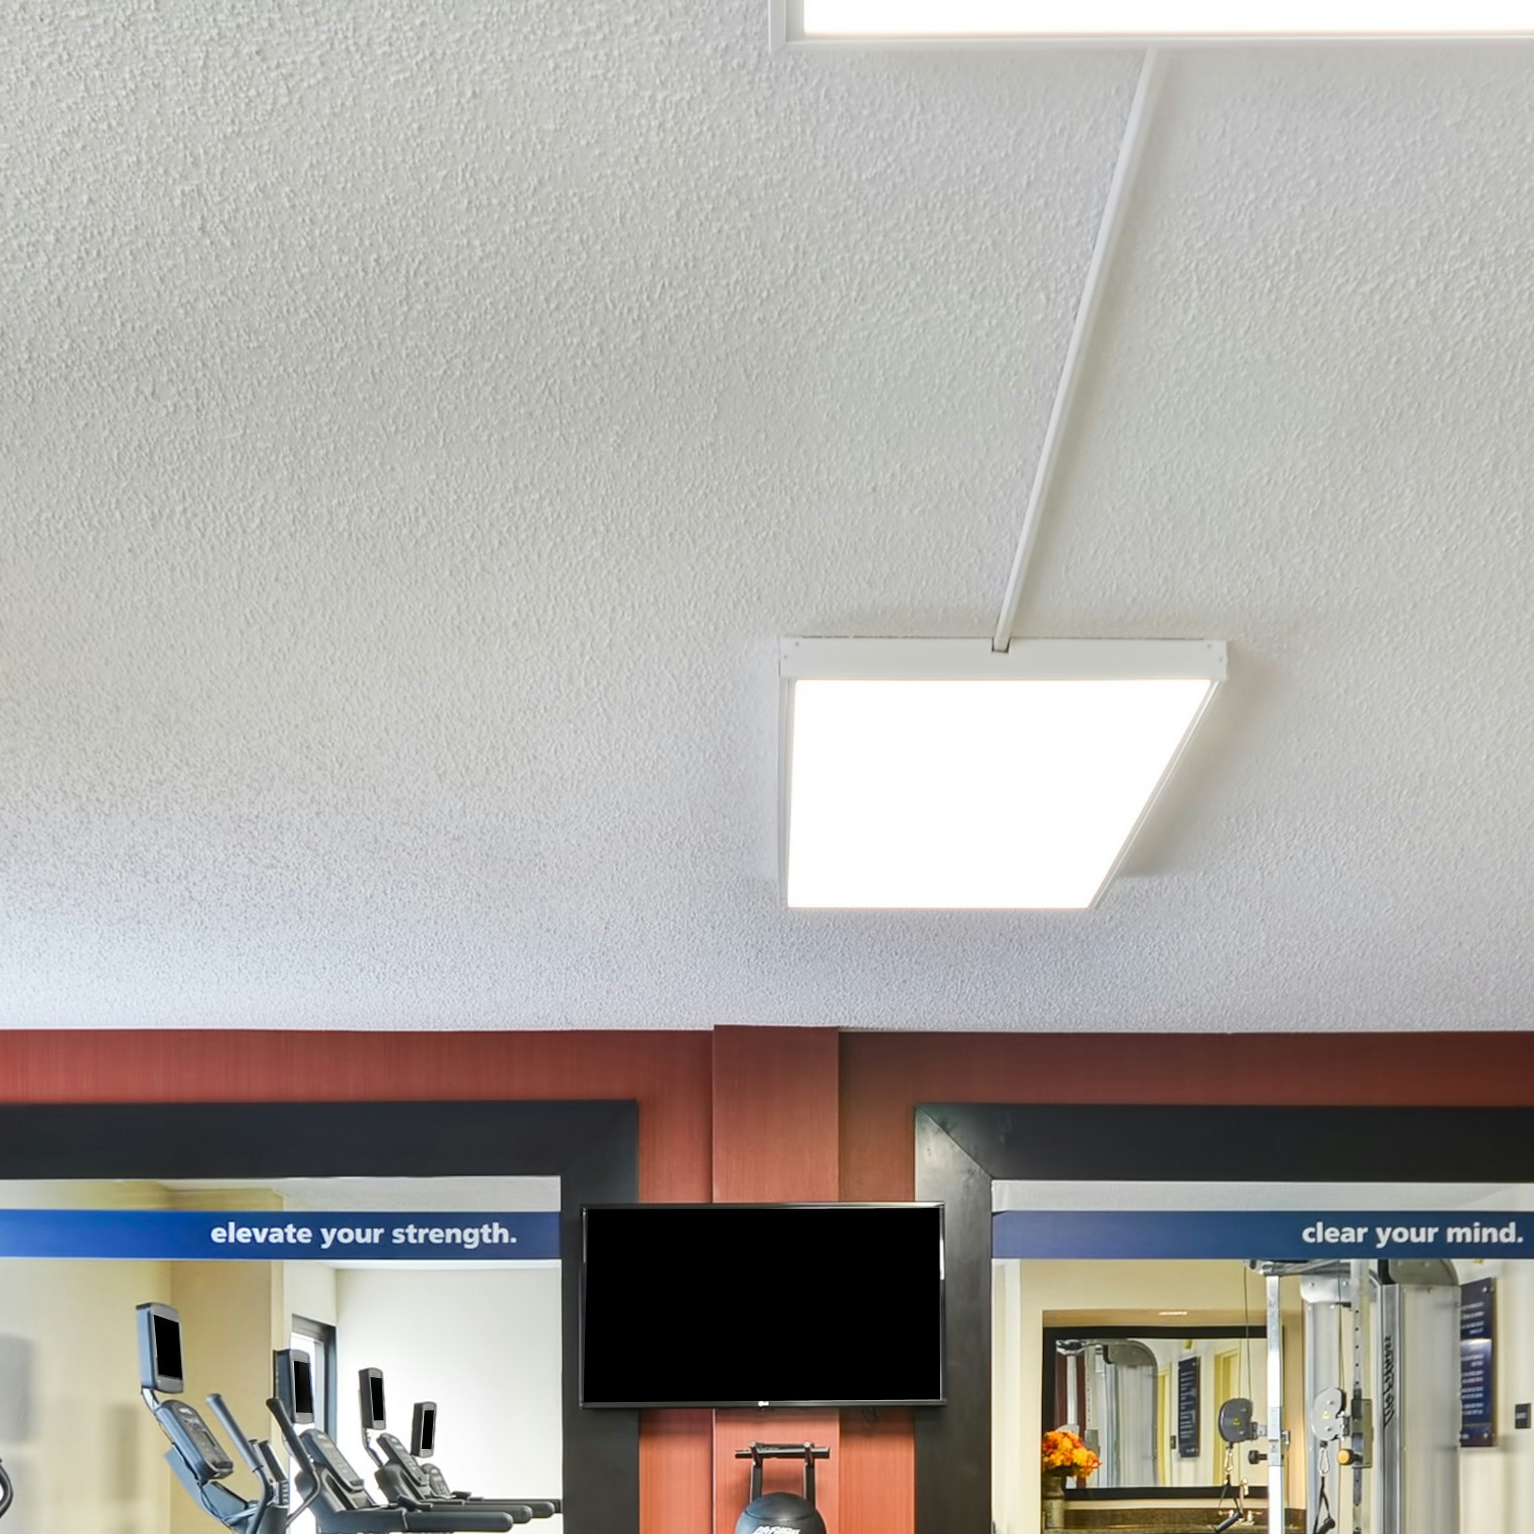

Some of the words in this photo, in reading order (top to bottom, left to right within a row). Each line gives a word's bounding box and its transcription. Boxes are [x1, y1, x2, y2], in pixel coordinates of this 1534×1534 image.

[210, 1221, 312, 1244] elevate
[319, 1225, 384, 1249] your
[391, 1222, 517, 1249] strength.
[1302, 1221, 1368, 1243] clear
[1375, 1226, 1439, 1249] your
[1446, 1221, 1524, 1243] mind.
